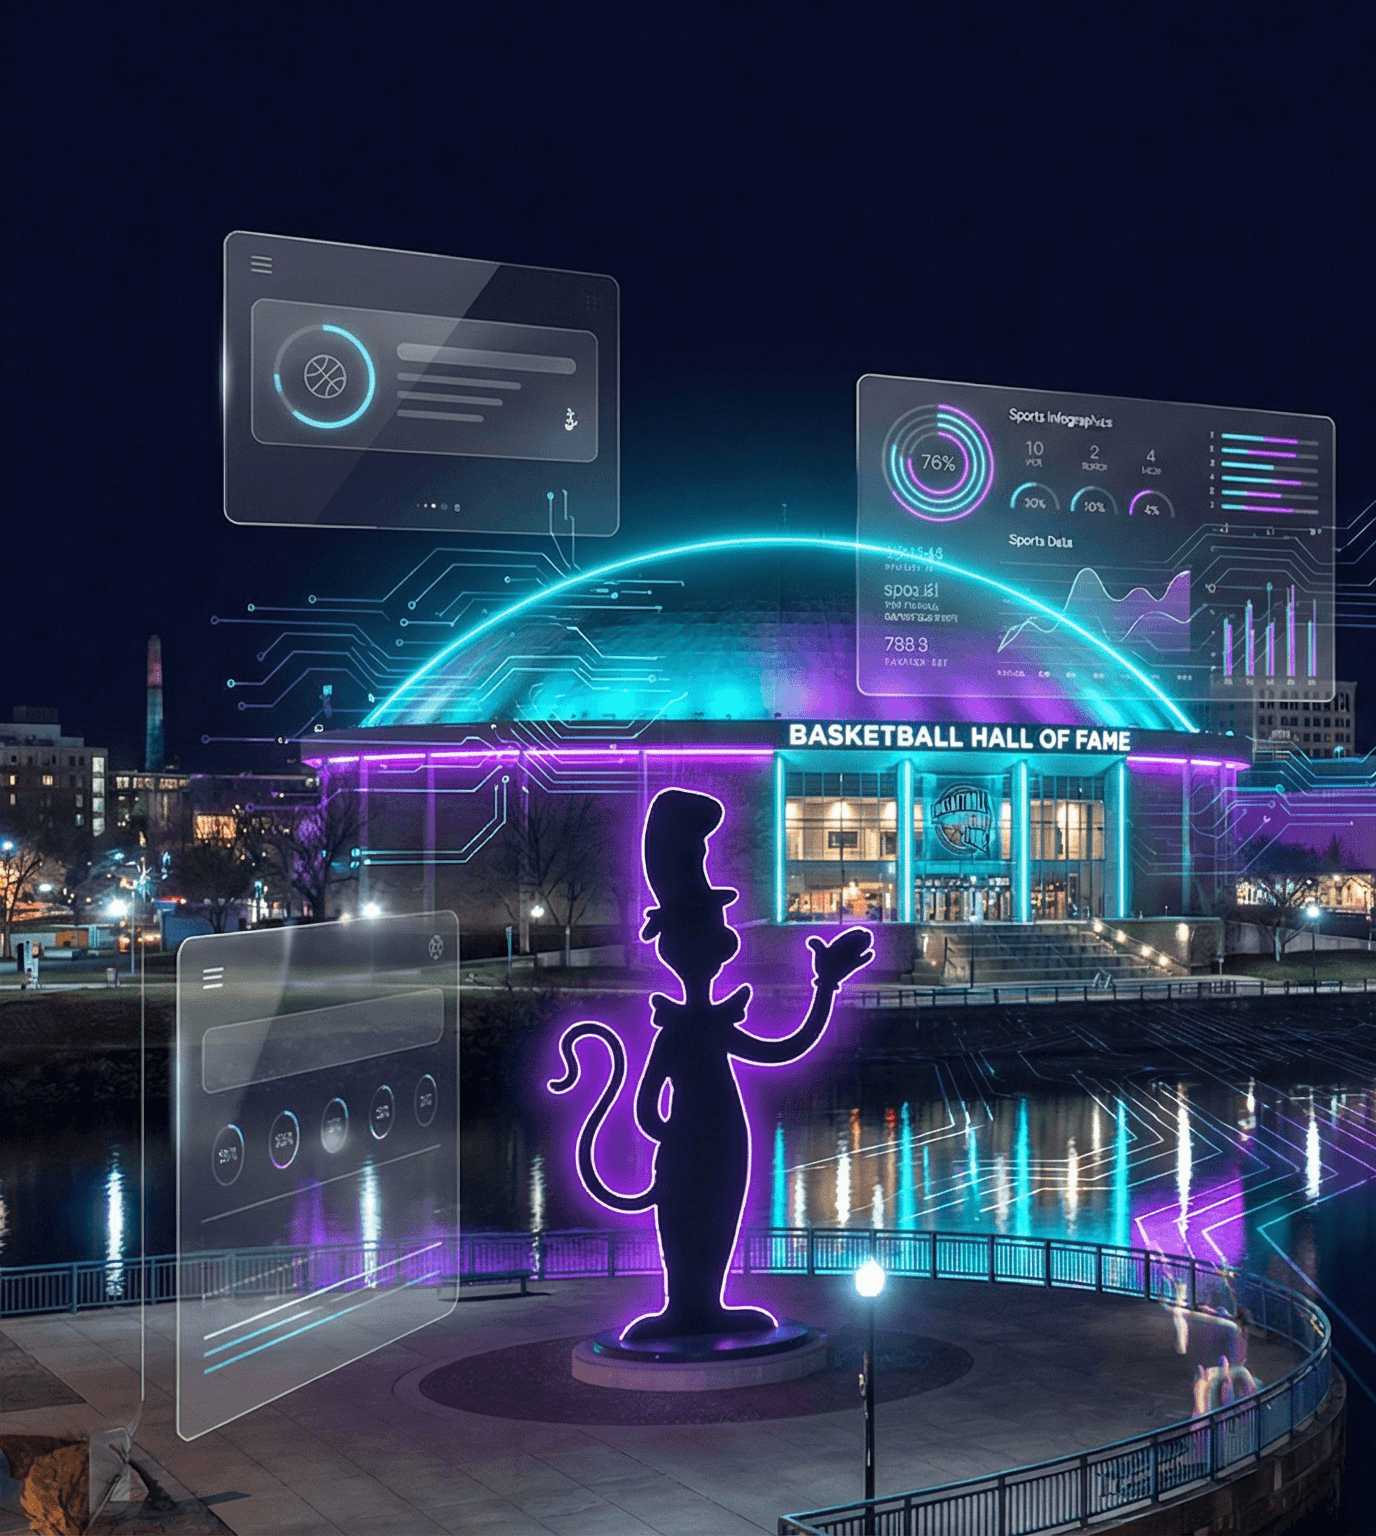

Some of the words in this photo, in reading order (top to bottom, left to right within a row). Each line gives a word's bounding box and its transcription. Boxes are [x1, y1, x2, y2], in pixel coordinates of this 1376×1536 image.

[1008, 408, 1045, 423] Sports
[1025, 440, 1044, 456] 10
[1089, 445, 1100, 459] 2
[1146, 449, 1156, 462] 4
[921, 454, 956, 471] 76%
[789, 723, 963, 748] BASKETBALL
[971, 727, 1033, 749] HALL
[1039, 729, 1070, 750] OF
[1076, 730, 1130, 751] FAME
